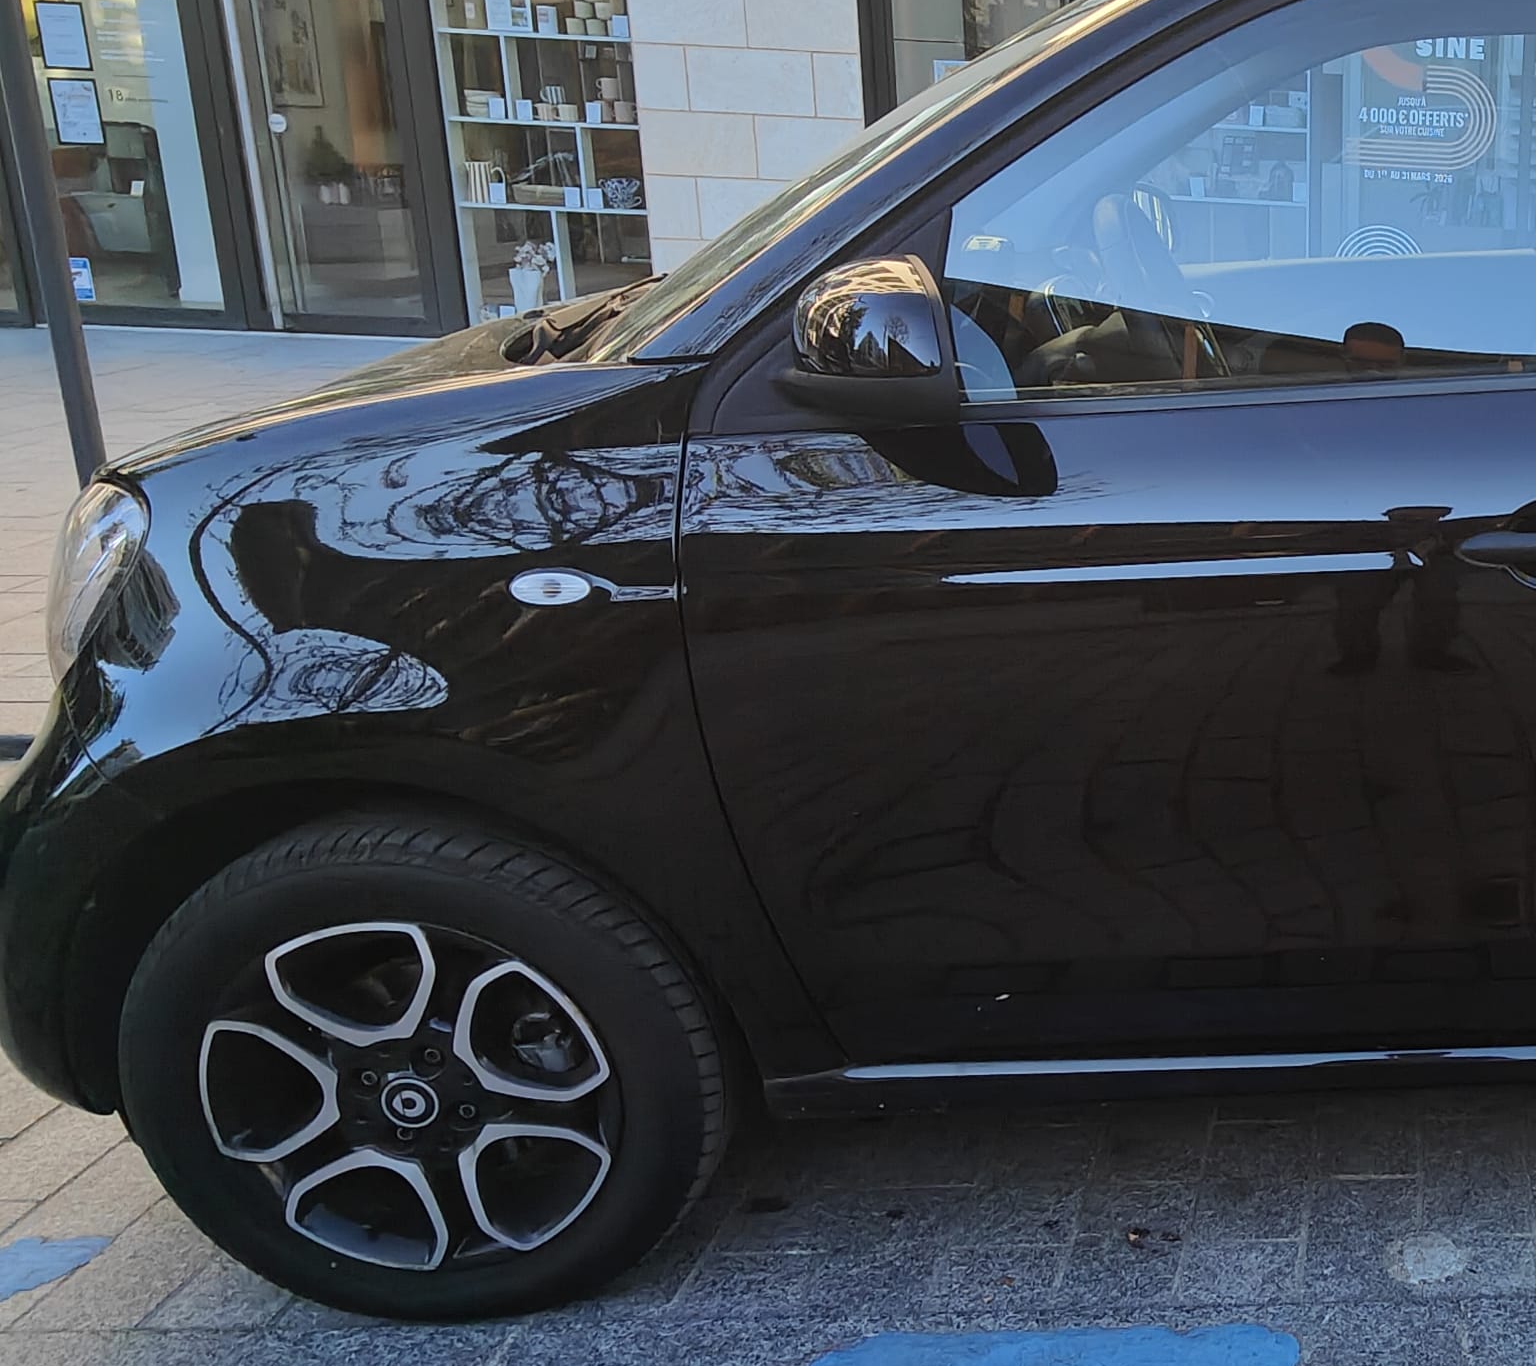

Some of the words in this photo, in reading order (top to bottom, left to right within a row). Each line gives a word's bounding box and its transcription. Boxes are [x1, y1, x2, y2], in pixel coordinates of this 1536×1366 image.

[1395, 126, 1416, 136] VOTRE
[1417, 127, 1445, 138] CUISINE
[1410, 171, 1431, 181] MARS
